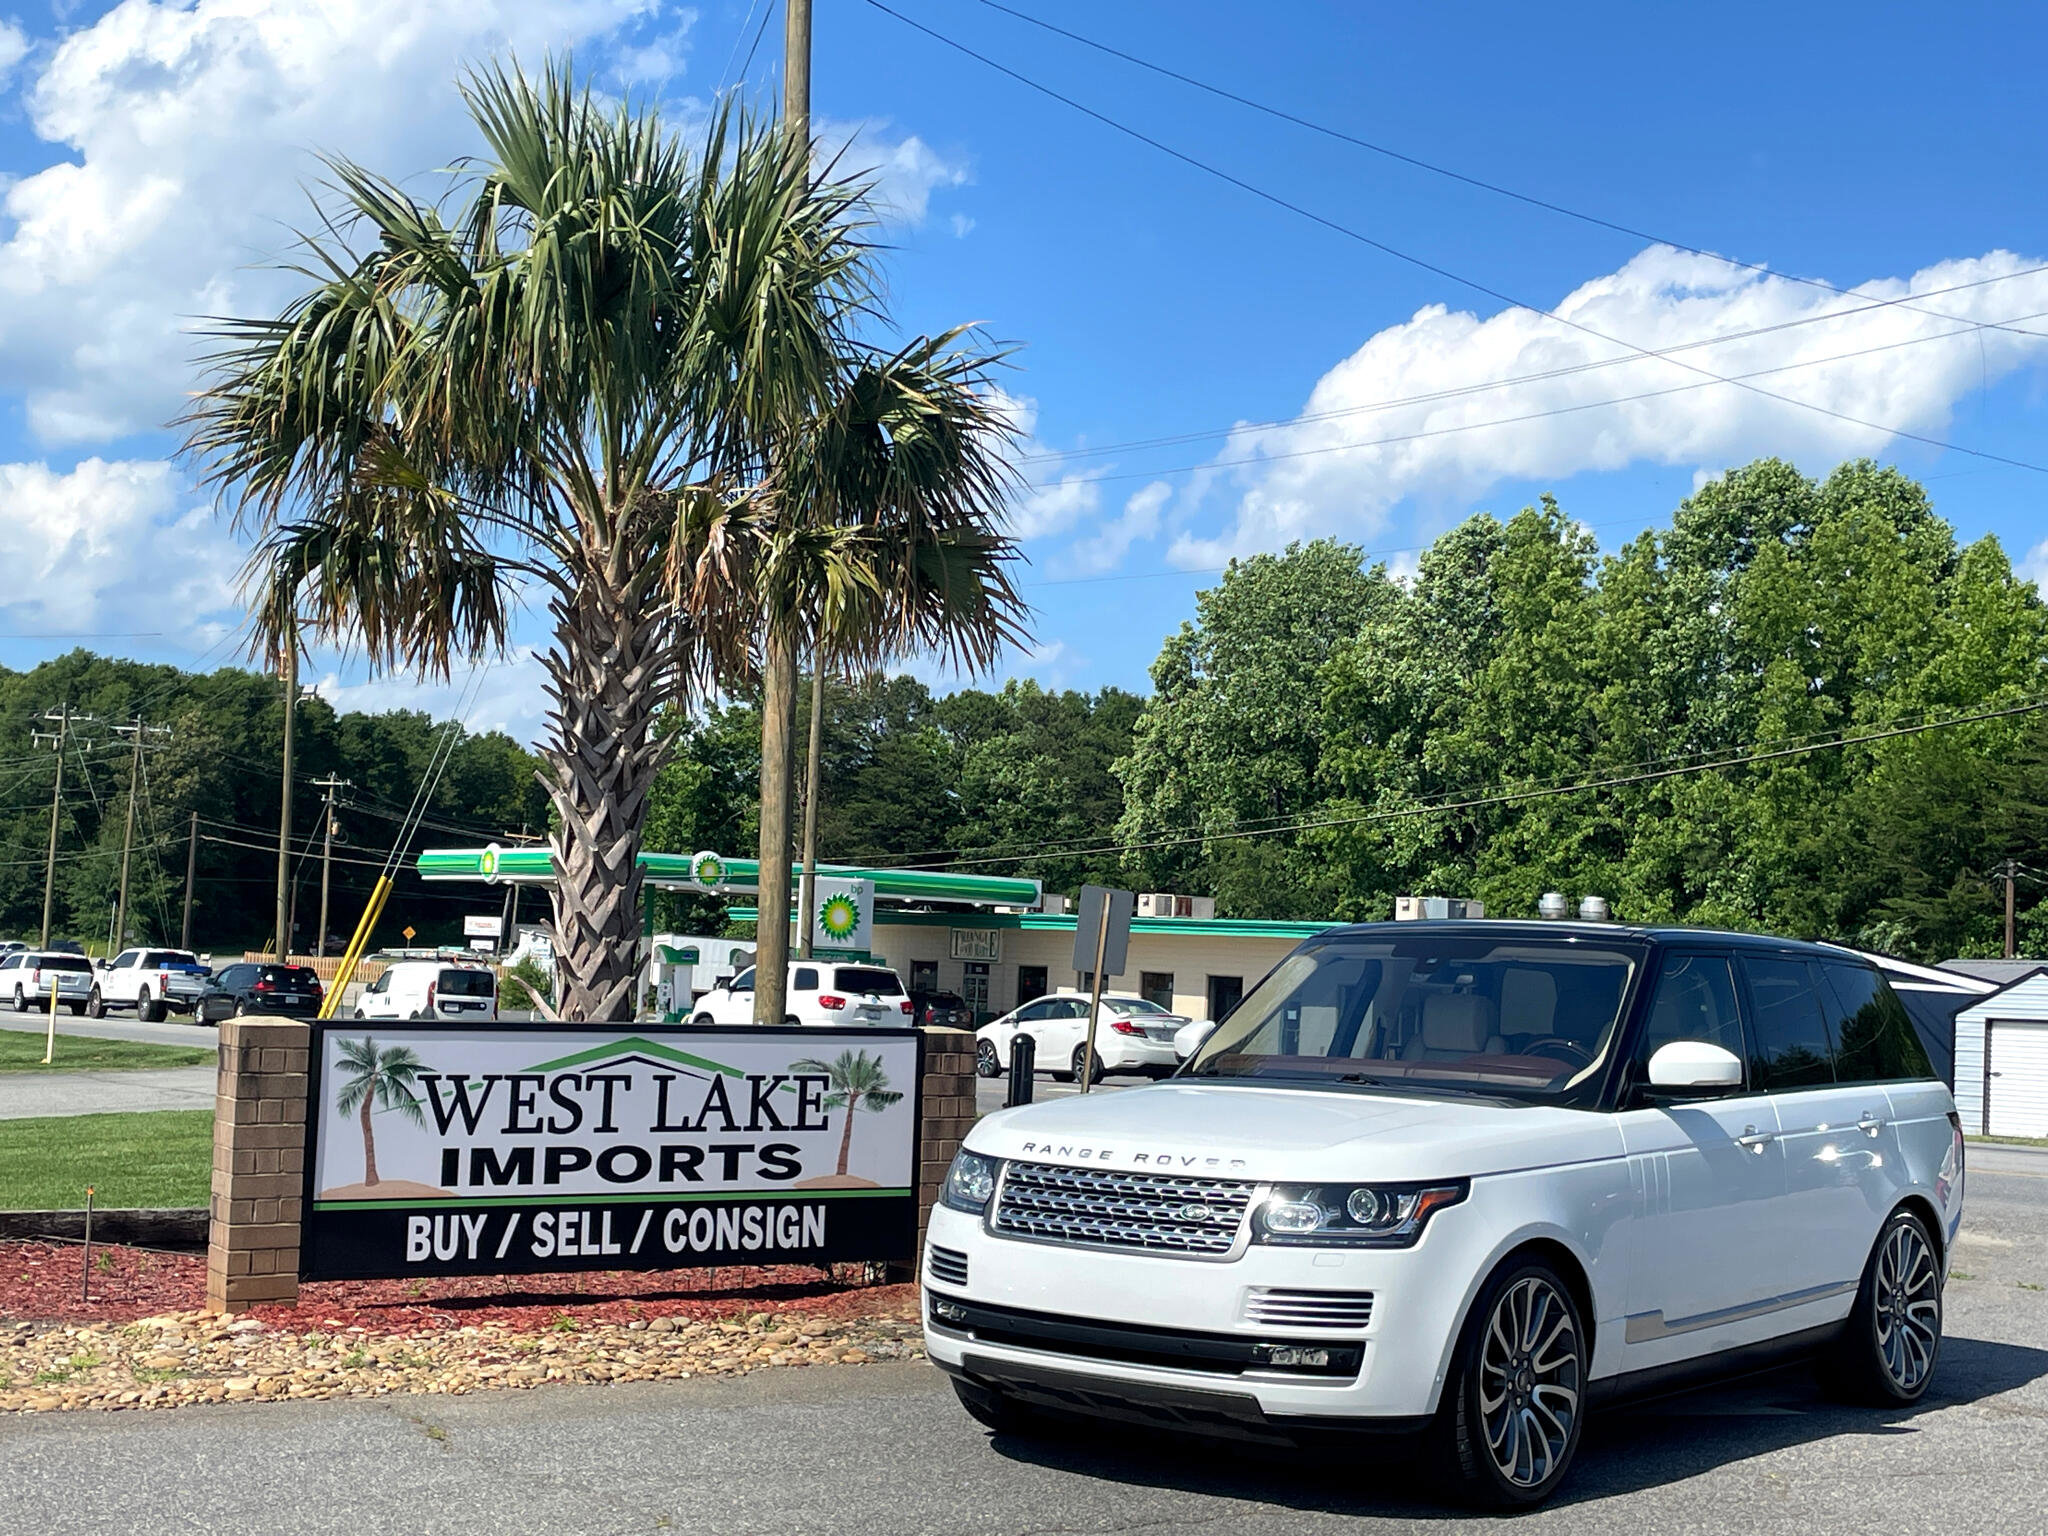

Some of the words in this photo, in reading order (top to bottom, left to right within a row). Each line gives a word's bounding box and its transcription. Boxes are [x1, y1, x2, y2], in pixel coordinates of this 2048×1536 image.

[850, 884, 864, 896] bp
[417, 1073, 632, 1137] WEST
[649, 1072, 830, 1133] LAKE
[440, 1143, 803, 1188] IMPORTS
[1022, 1141, 1114, 1161] RANGE
[406, 1213, 488, 1262] BUY
[495, 1213, 521, 1259] /
[531, 1210, 621, 1257] SELL
[629, 1209, 654, 1254] /
[663, 1205, 827, 1254] CONSIGN
